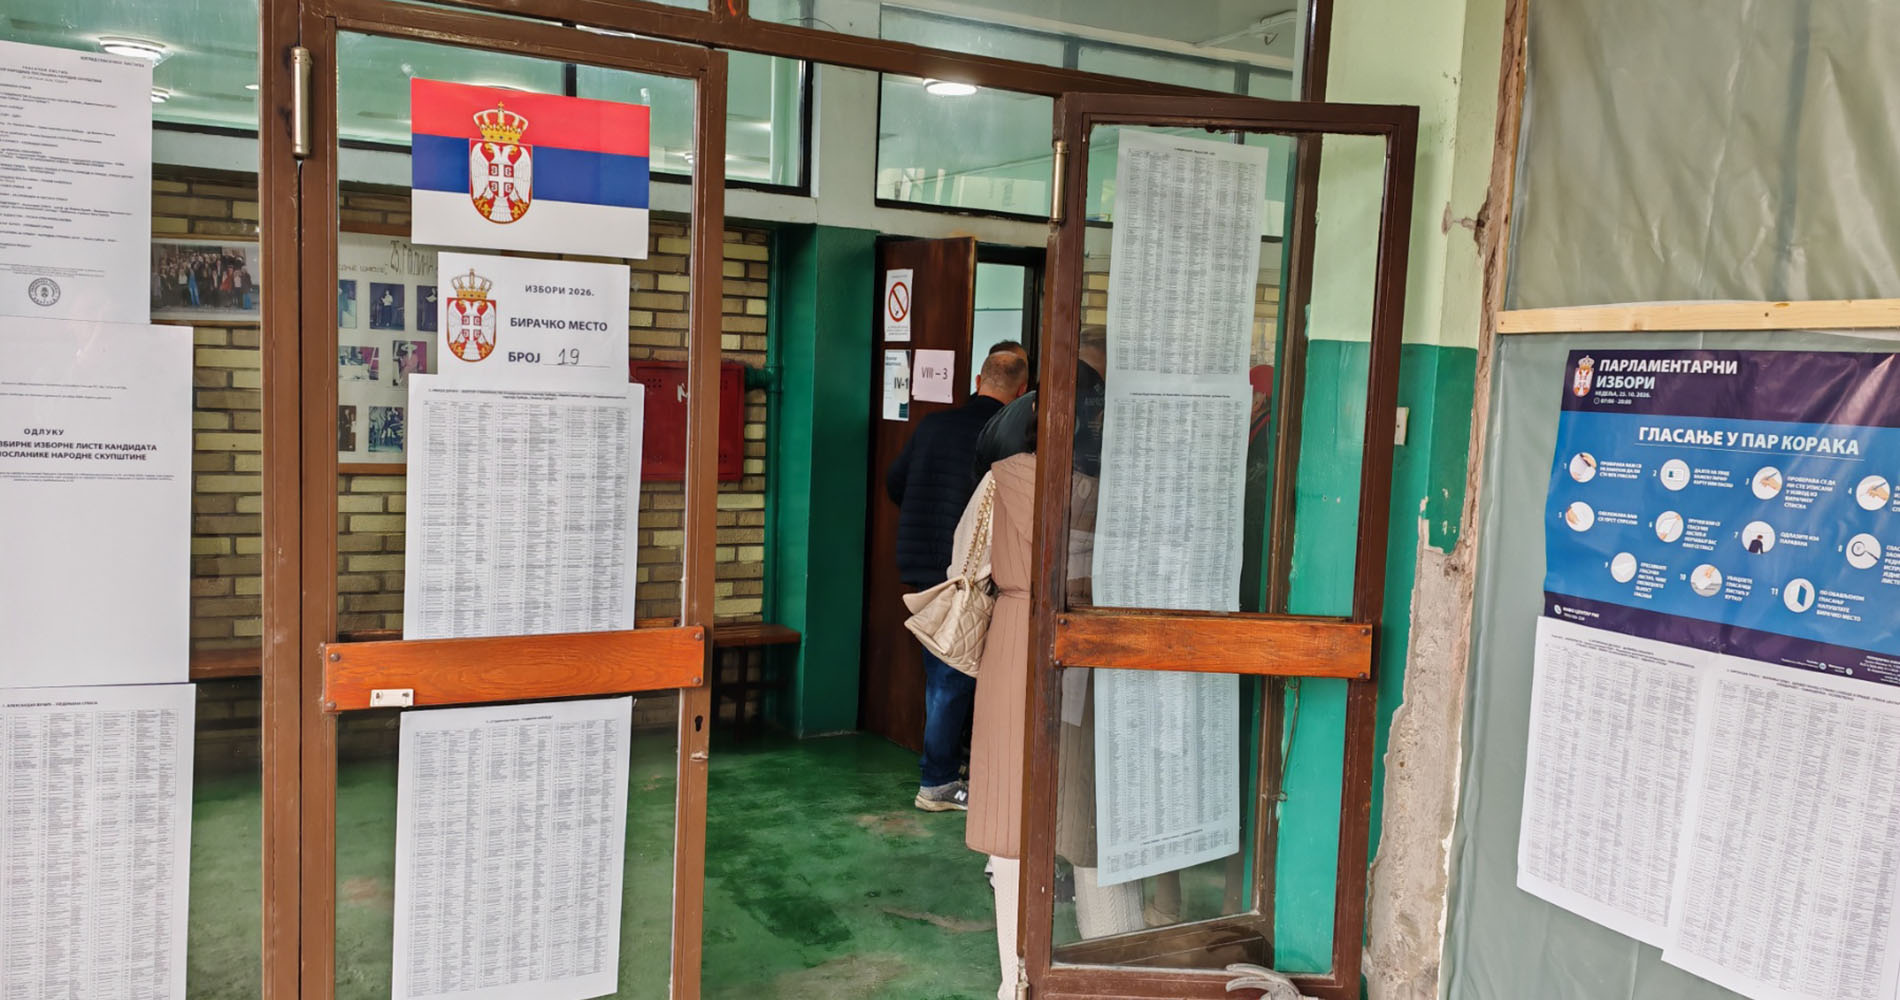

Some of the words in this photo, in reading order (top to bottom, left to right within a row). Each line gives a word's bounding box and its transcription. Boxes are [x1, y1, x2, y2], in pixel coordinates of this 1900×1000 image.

[525, 285, 566, 295] ИЗБОРИ
[568, 288, 595, 296] 2026.
[510, 317, 566, 330] БИРАЧКО
[568, 321, 608, 332] МЕСТО
[508, 352, 541, 364] БРОЈ
[557, 348, 580, 366] 19
[921, 367, 934, 379] VIII
[942, 367, 948, 380] 3
[1599, 359, 1738, 375] ПАРЛАМЕНТАРНИ
[894, 377, 909, 390] IV-1
[1596, 375, 1655, 389] ИЗБОРИ
[23, 428, 64, 436] ОДЛУКУ
[34, 441, 74, 450] ИЗБОРНЕ
[76, 442, 103, 450] ЛИСТЕ
[1638, 426, 1723, 446] ГЛАСАЊЕ
[1726, 432, 1739, 447] У
[1741, 432, 1779, 449] ПАР
[1780, 436, 1860, 455] КОРАКА
[51, 452, 92, 460] НАРОДНЕ
[94, 453, 147, 461] СКУПШТИНЕ
[953, 790, 968, 802] N
